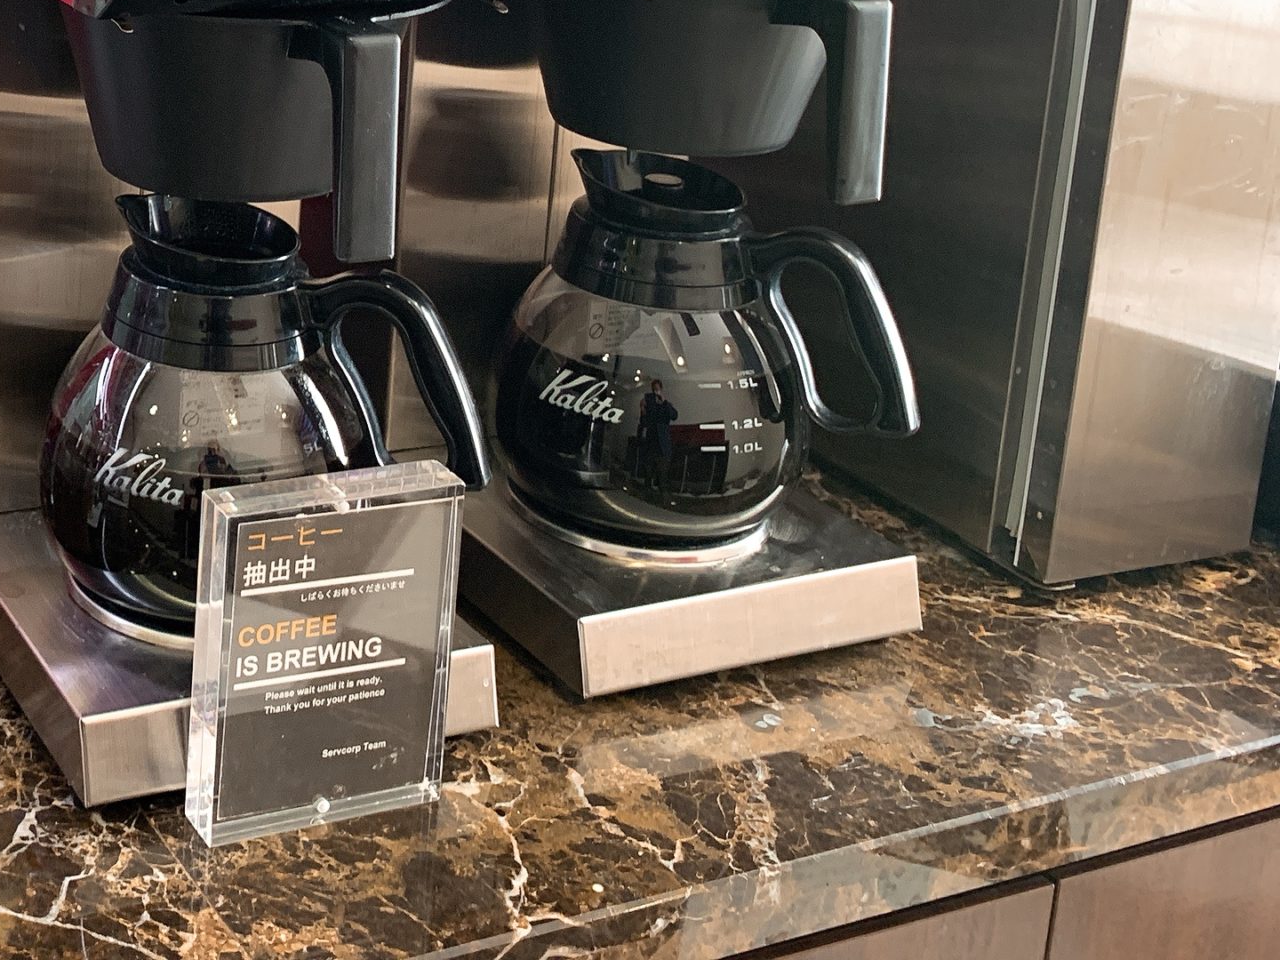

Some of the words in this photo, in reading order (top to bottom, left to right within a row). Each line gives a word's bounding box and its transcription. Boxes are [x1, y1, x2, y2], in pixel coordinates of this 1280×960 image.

[538, 368, 625, 424] Kalita
[726, 377, 758, 390] 1.5L
[731, 418, 763, 430] 1.2L
[733, 441, 763, 453] 1.0L
[92, 447, 184, 506] Kalita
[247, 525, 343, 552] コーヒー
[243, 554, 317, 587] 抽出中
[300, 580, 407, 602] しばらくお待ちくださいませ
[238, 614, 338, 647] COFFEE
[235, 655, 258, 677] IS
[266, 636, 382, 673] BREWING
[264, 703, 291, 715] Thank
[293, 700, 310, 712] you
[312, 697, 325, 707] for
[326, 695, 347, 707] your
[348, 688, 385, 702] patience
[265, 690, 294, 701] Please
[297, 686, 315, 696] wait
[317, 681, 336, 693] until
[338, 680, 345, 689] it
[346, 680, 354, 688] is
[322, 743, 361, 759] Servcorp
[363, 740, 386, 751] Team
